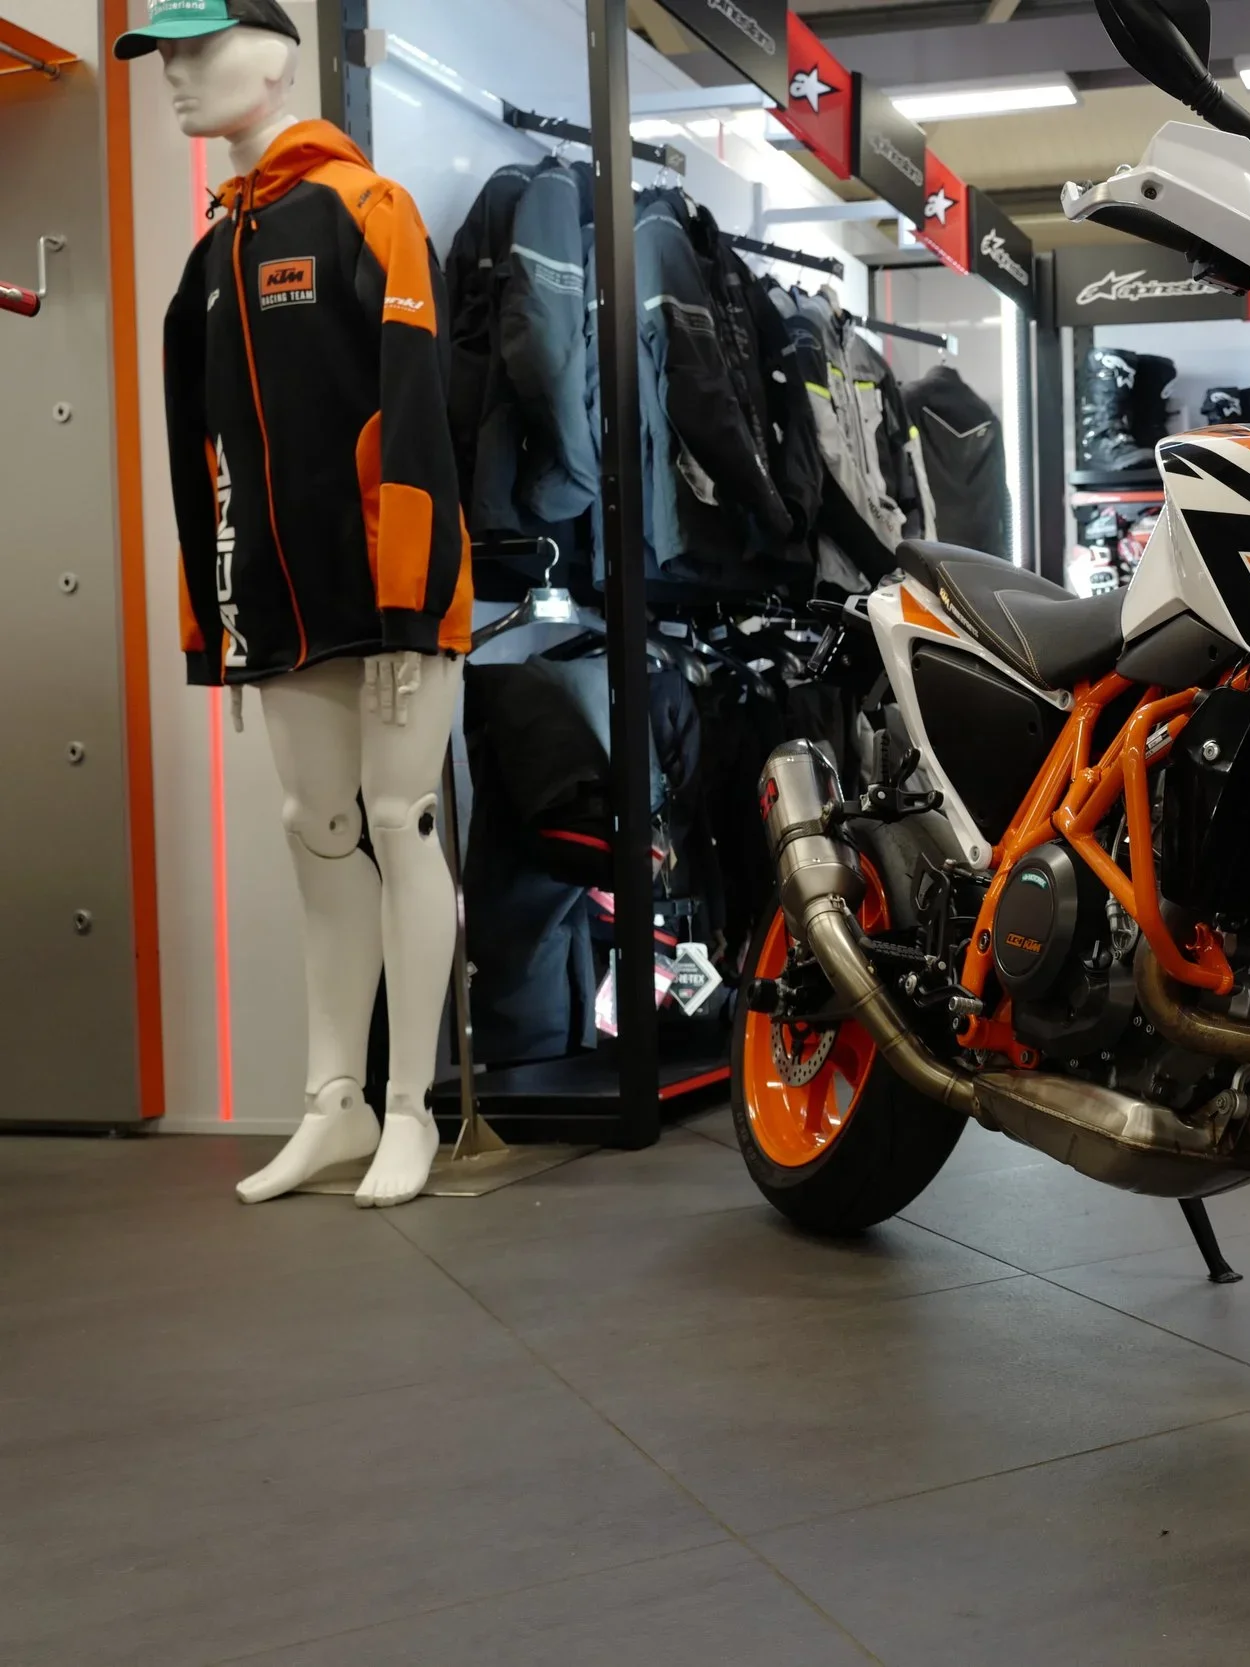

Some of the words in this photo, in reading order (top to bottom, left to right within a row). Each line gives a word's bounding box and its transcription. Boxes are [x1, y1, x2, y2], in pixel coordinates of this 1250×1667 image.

[266, 267, 304, 287] KTM
[261, 292, 288, 306] RACING
[290, 290, 313, 301] TEAM
[215, 432, 249, 668] RACING
